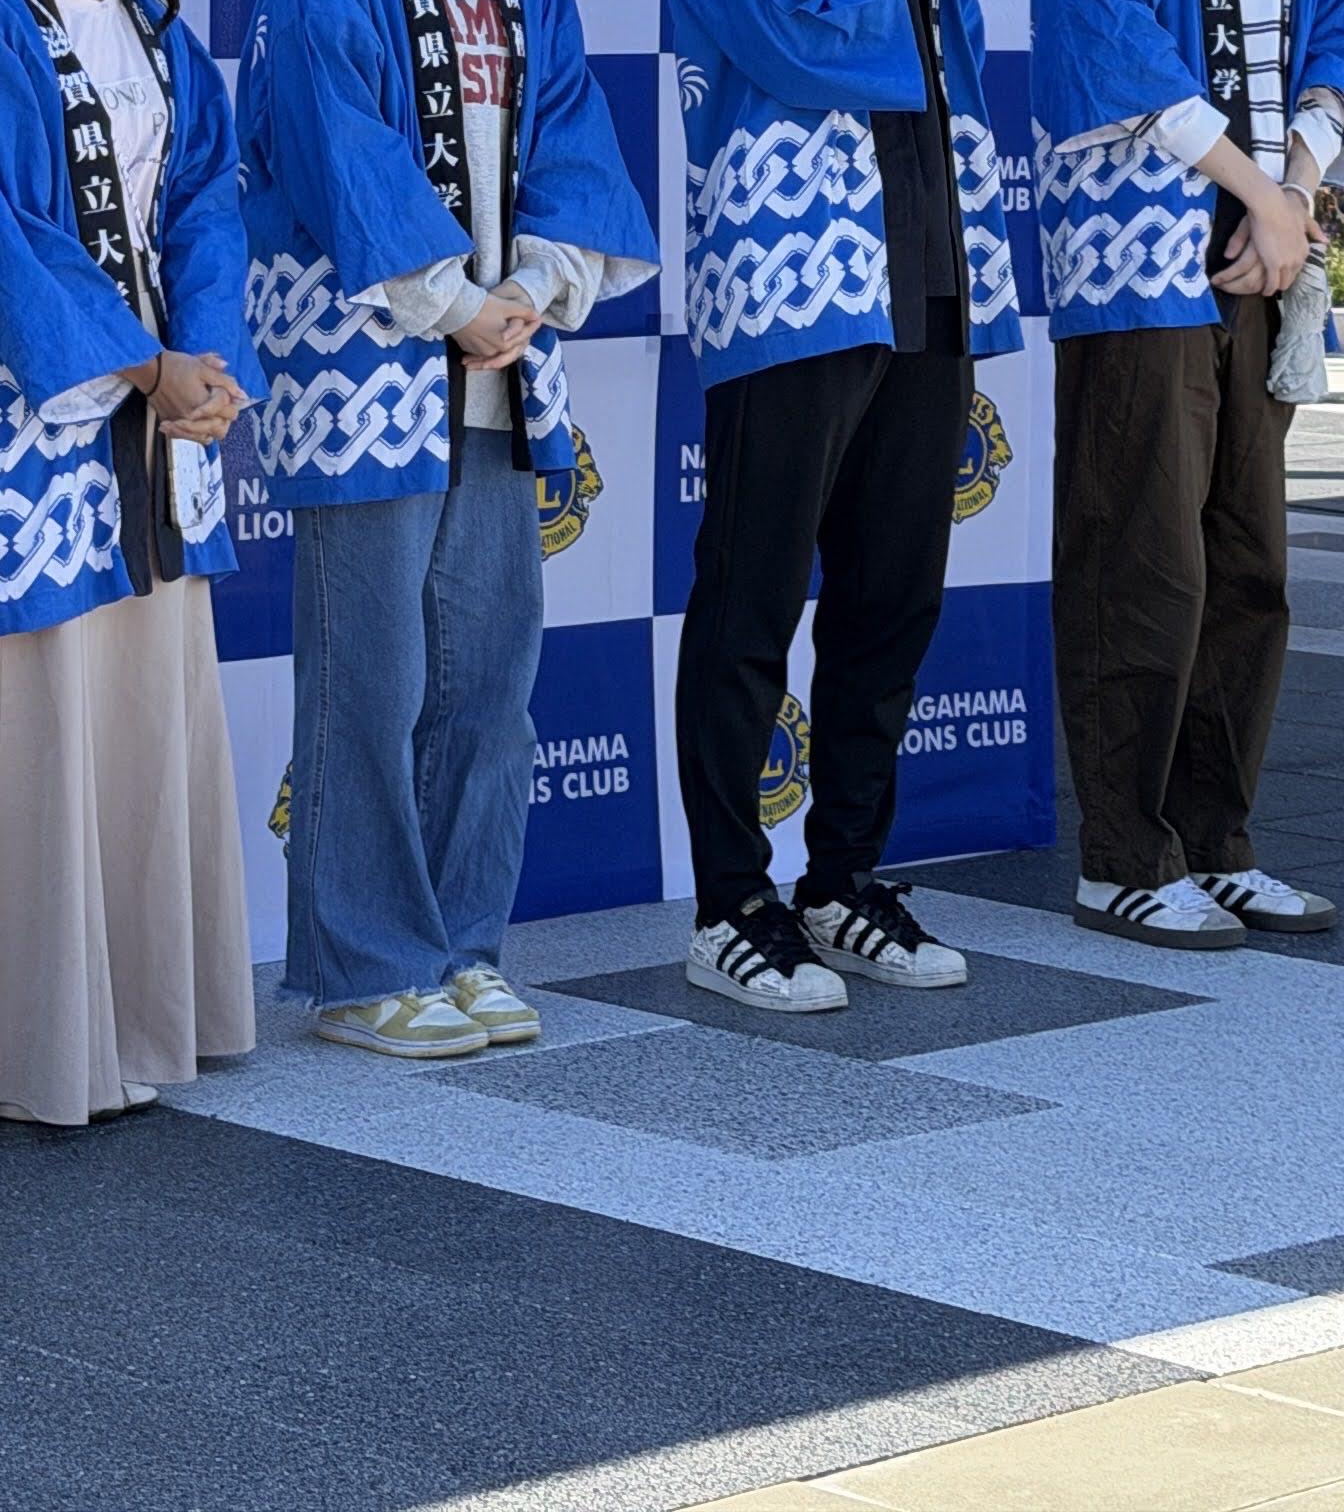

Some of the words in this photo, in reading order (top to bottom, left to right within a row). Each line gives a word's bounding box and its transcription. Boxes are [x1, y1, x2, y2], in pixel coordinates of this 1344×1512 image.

[238, 509, 294, 541] LIO
[966, 719, 1027, 747] CLUB
[533, 734, 629, 768] AHAMA
[562, 766, 629, 799] CLUB
